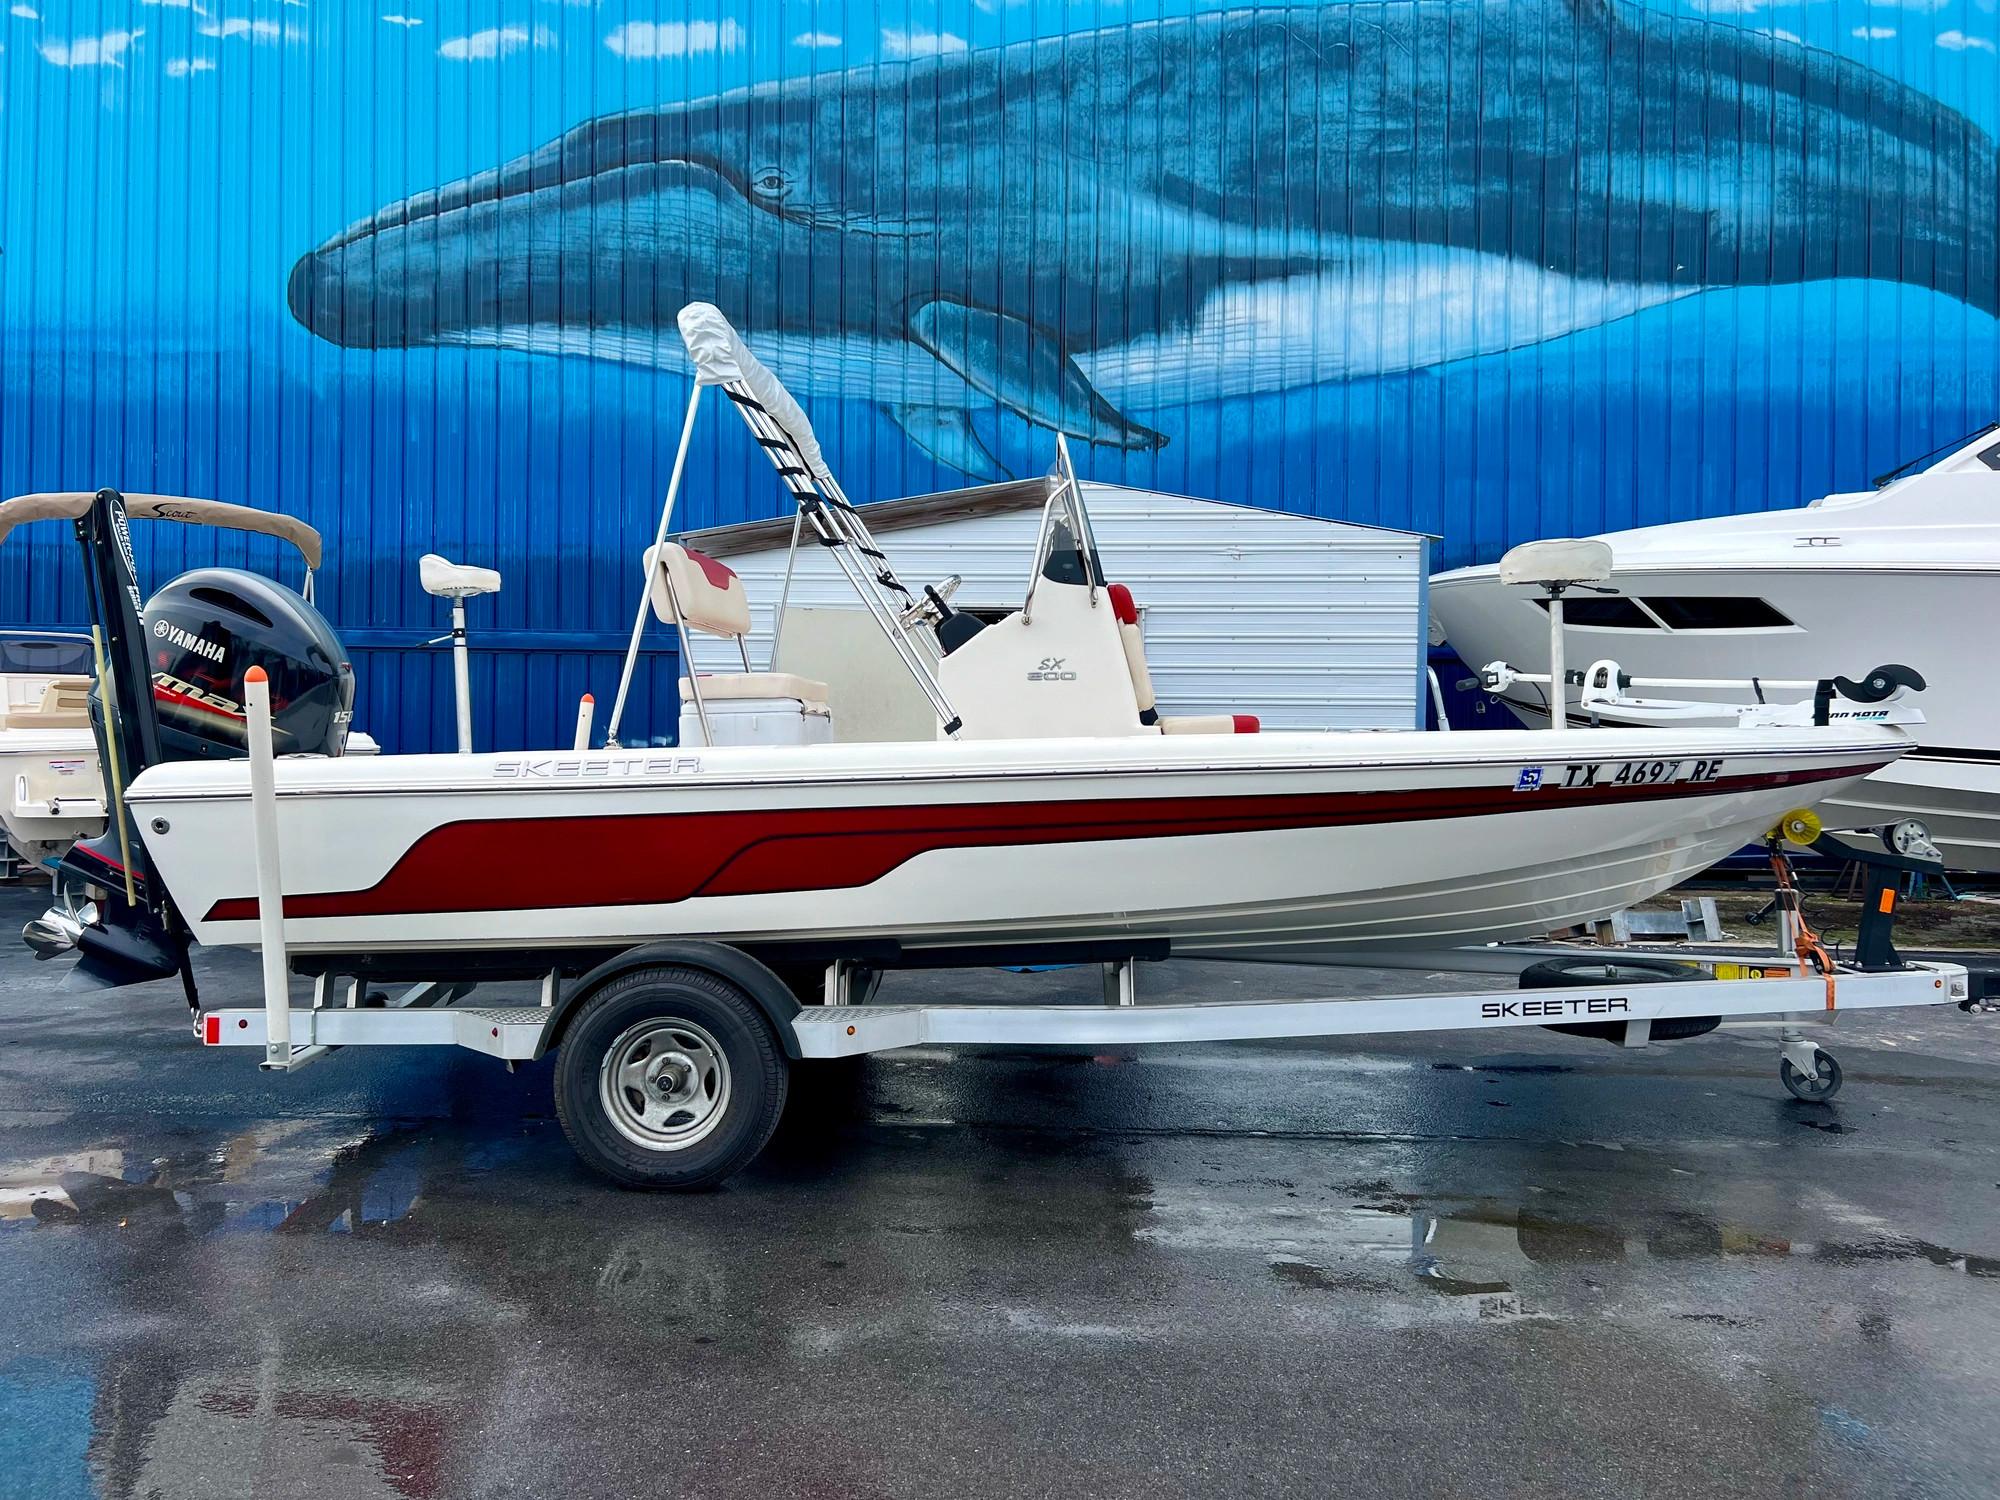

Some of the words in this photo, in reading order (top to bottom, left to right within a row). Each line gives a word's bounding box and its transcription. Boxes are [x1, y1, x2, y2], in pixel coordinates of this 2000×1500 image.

[152, 503, 198, 519] Scout
[167, 625, 226, 663] YAMAHA
[1038, 658, 1066, 671] SX
[1027, 672, 1076, 681] 200
[333, 710, 354, 724] 150
[1851, 710, 1889, 718] KOTA
[493, 757, 702, 777] SKEETER
[1565, 764, 1600, 787] TX
[1614, 761, 1681, 785] 4697
[1689, 759, 1724, 782] RE
[1481, 997, 1629, 1018] SKEETER
